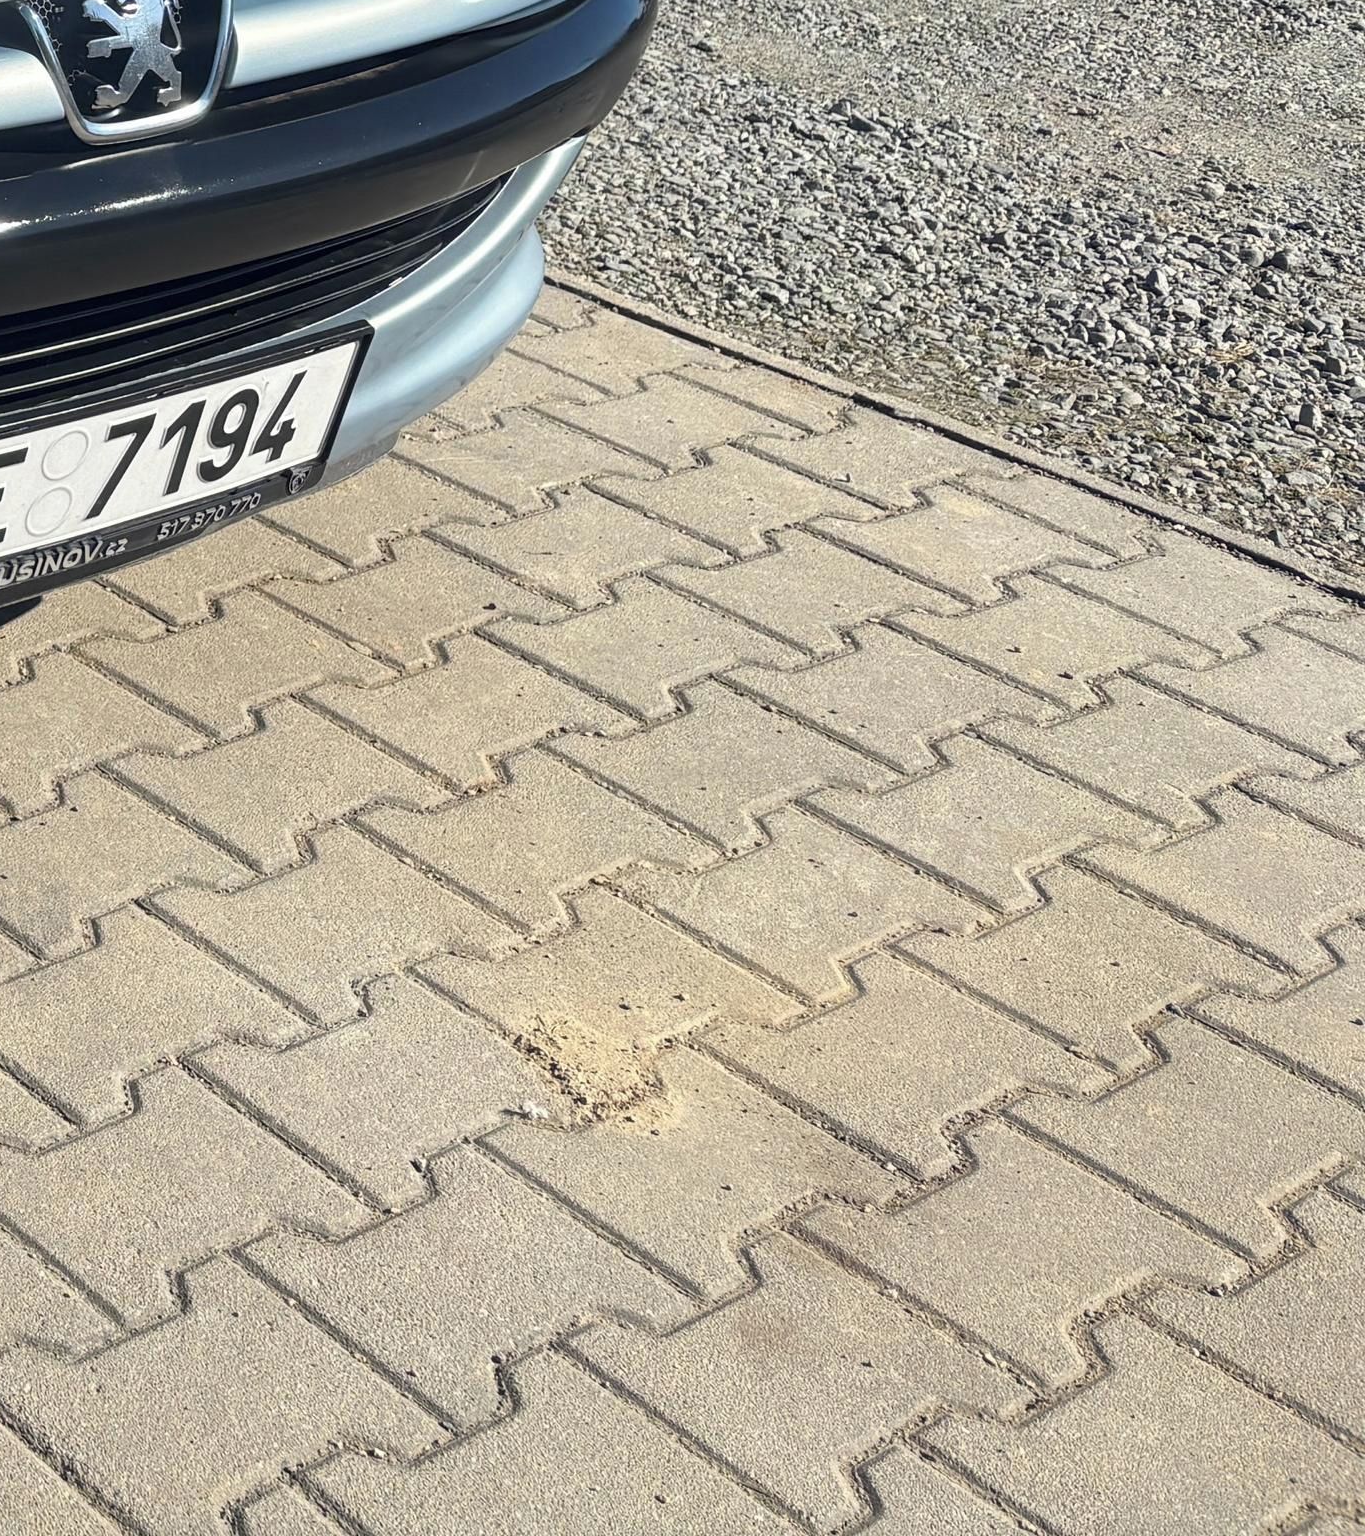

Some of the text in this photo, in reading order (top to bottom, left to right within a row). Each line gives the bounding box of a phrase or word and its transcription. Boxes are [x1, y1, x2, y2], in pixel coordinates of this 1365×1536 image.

[83, 369, 309, 521] 7194
[157, 515, 191, 542] 517
[229, 492, 262, 517] 770
